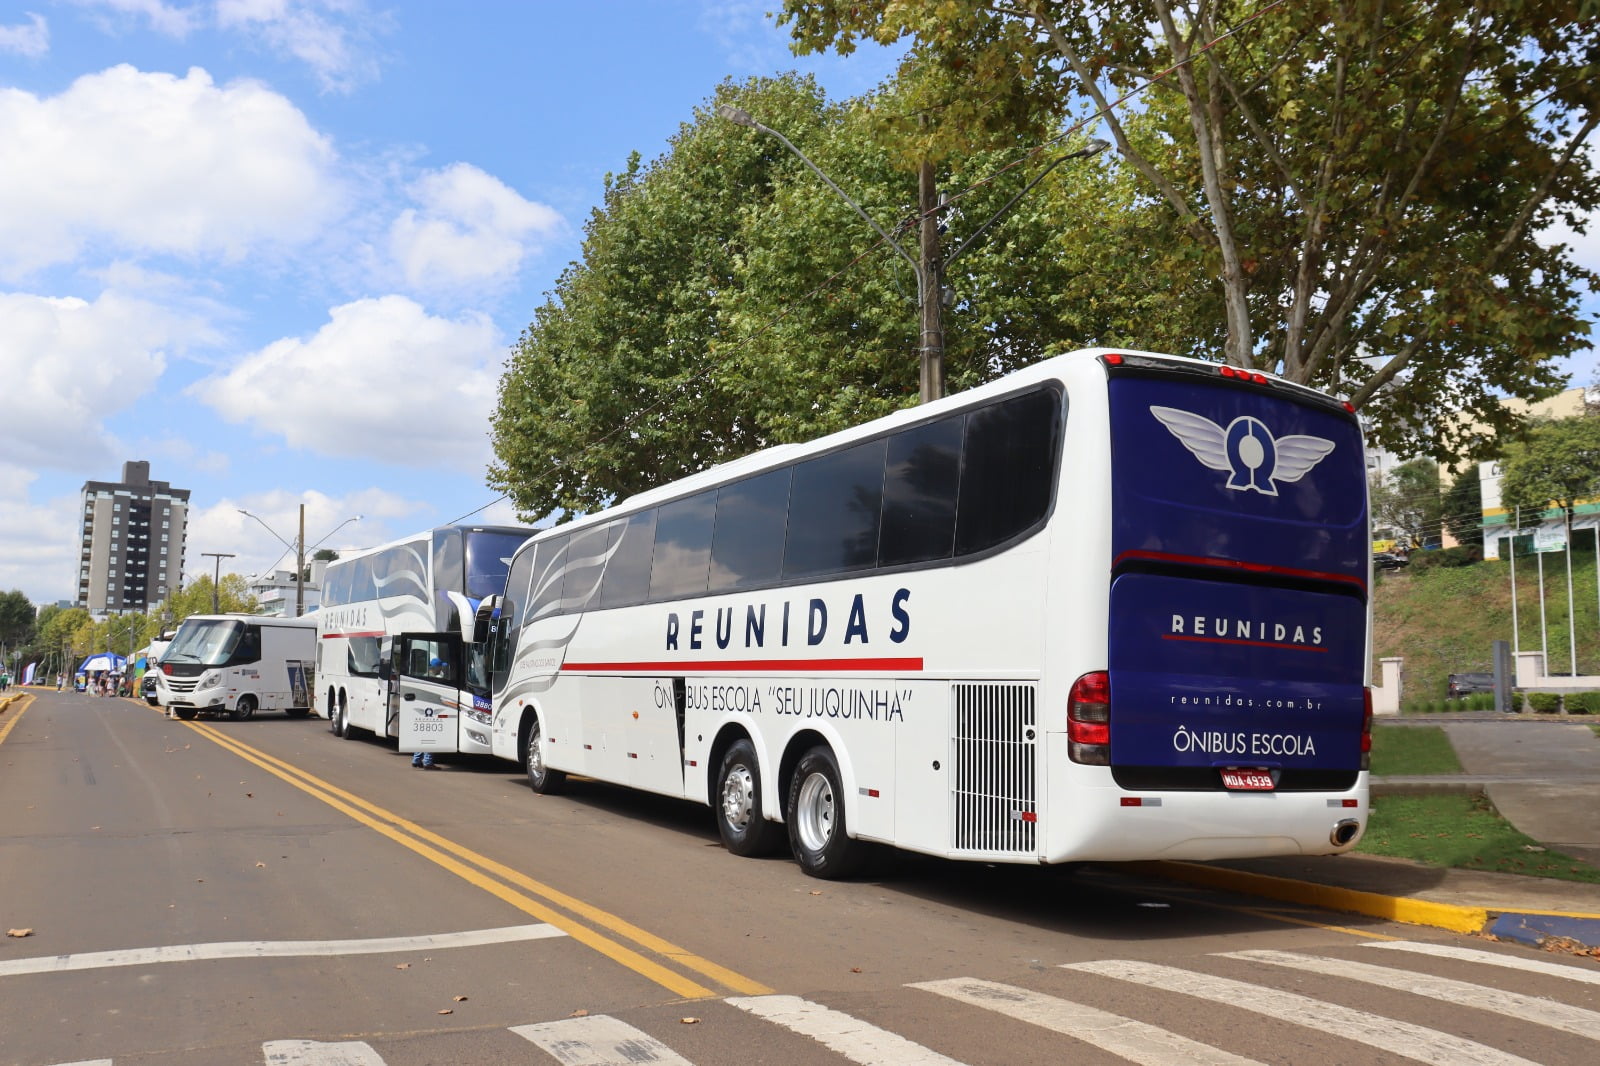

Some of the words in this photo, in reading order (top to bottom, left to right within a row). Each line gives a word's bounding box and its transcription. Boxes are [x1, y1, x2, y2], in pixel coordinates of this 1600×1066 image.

[325, 607, 367, 630] REUNIDAS
[666, 588, 911, 651] REUNIDAS
[1171, 614, 1322, 645] REUNIDAS
[712, 686, 762, 713] ESCOLA
[1171, 694, 1322, 710] reunidas.com.br
[413, 723, 443, 732] 38803
[1173, 724, 1247, 754] ÔNIBUS
[1251, 733, 1316, 756] ESCOLA
